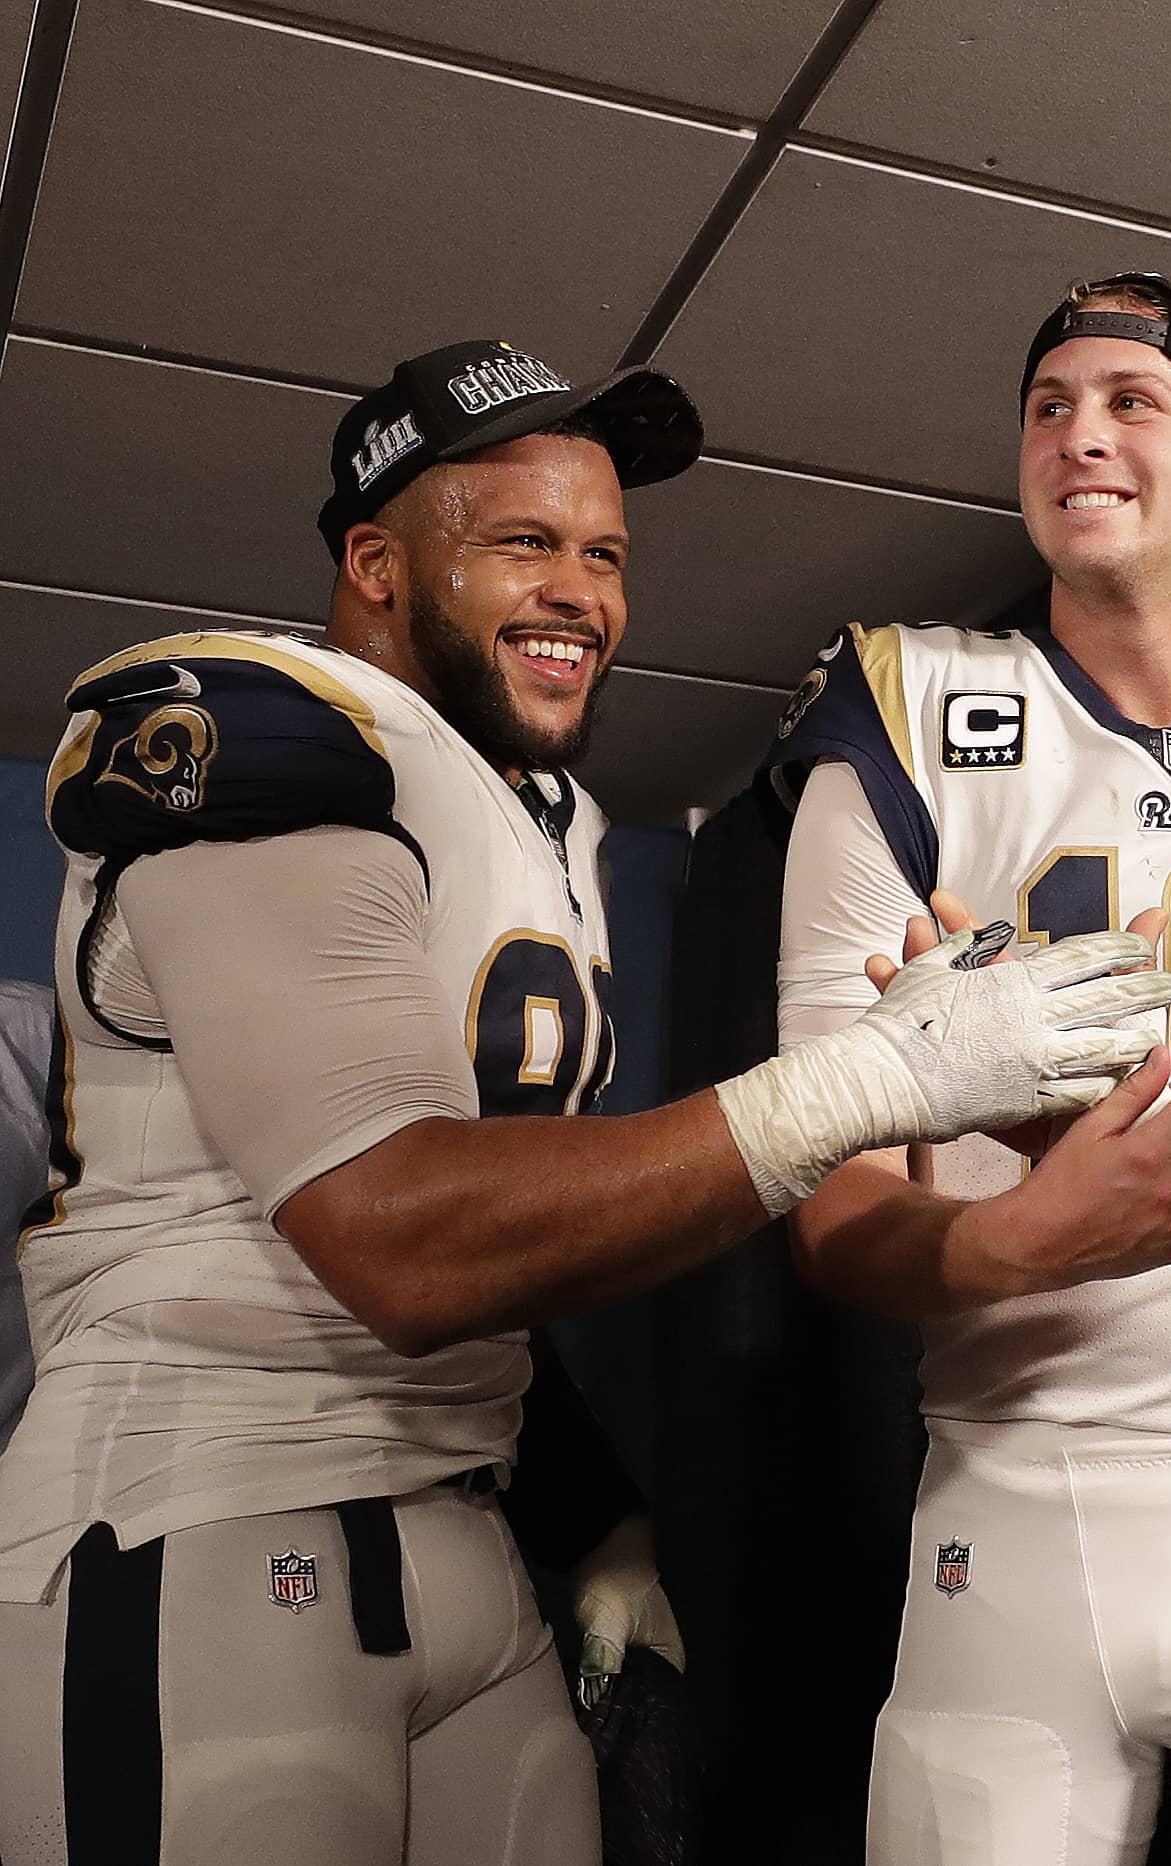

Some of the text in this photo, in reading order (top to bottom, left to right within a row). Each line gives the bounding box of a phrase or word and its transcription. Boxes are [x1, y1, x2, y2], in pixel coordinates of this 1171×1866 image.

[448, 358, 571, 415] CHAM
[948, 694, 1020, 748] C
[276, 1576, 314, 1601] NFL
